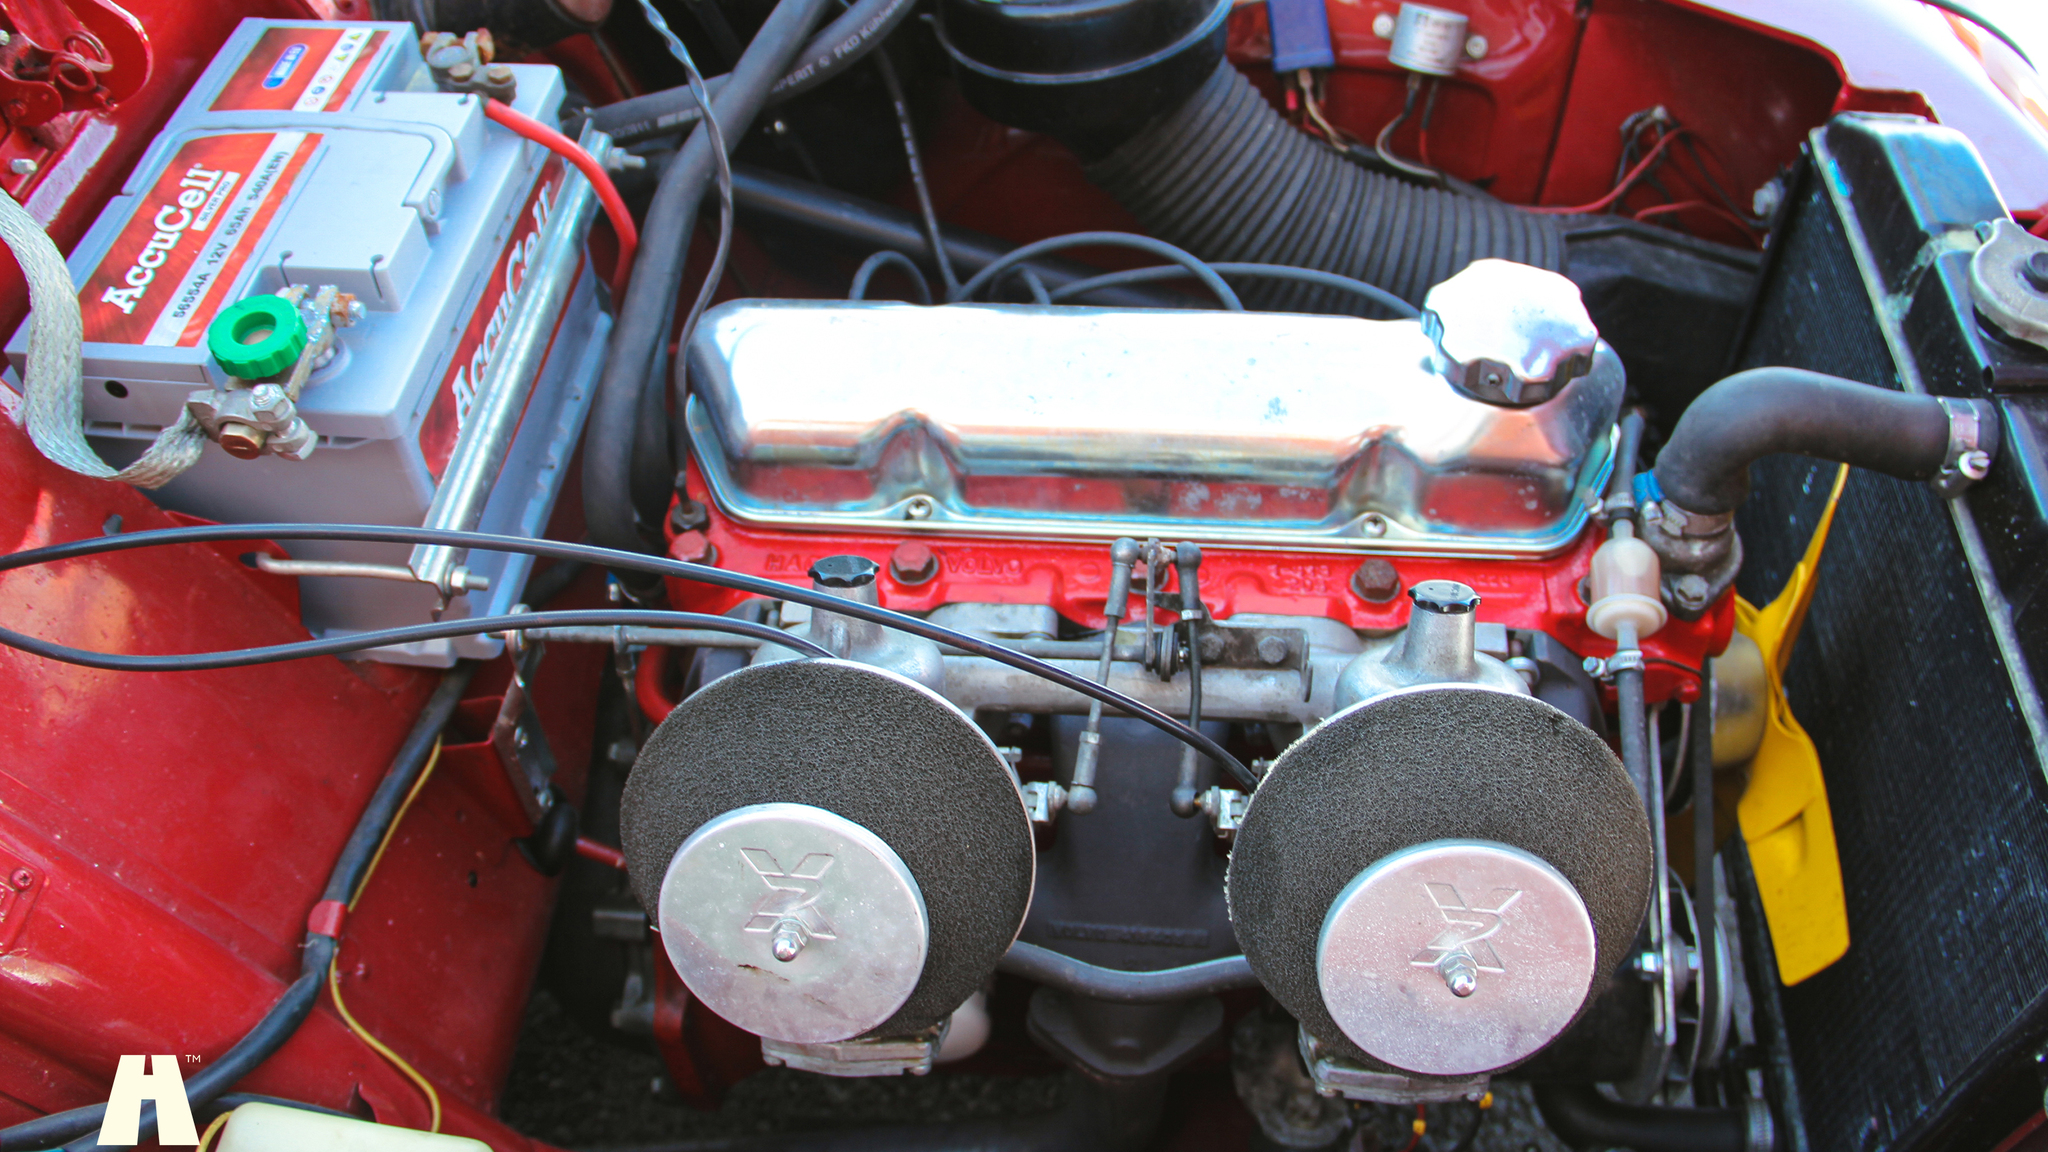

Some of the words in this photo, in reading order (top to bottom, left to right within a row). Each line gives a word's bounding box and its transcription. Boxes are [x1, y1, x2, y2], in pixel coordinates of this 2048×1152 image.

[198, 195, 219, 222] SILVER
[215, 180, 231, 197] PRO
[101, 167, 223, 314] AccuCell
[206, 242, 229, 266] 12V
[224, 206, 252, 236] 65Ah
